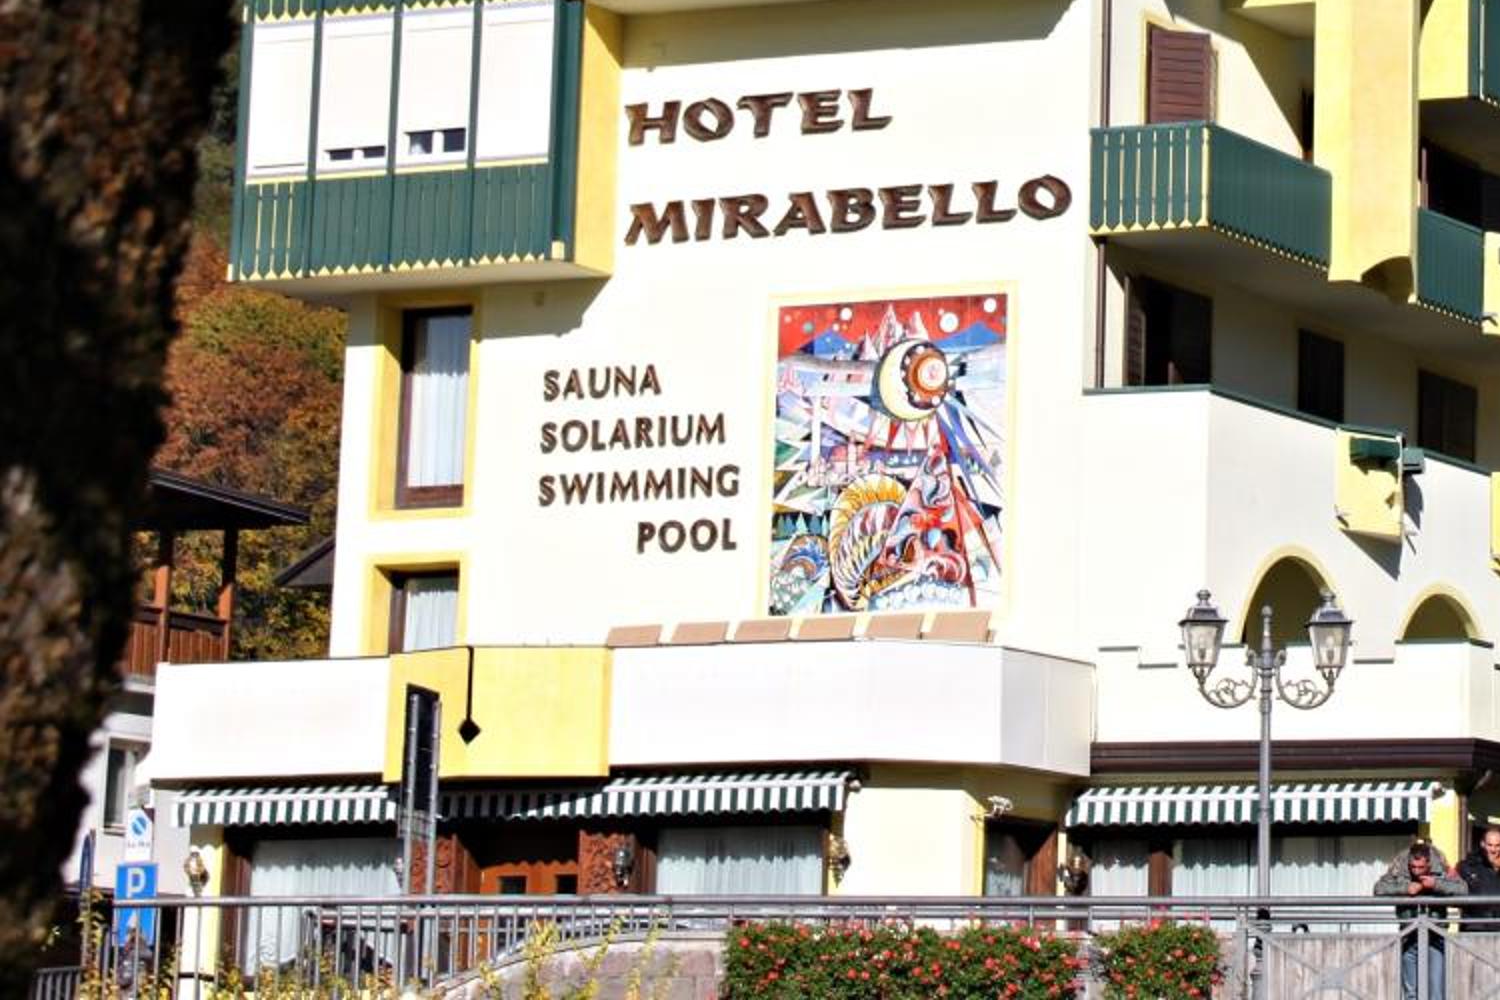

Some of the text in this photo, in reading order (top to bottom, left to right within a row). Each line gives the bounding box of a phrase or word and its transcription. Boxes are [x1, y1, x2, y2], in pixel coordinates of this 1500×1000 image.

[625, 87, 892, 146] HOTEL
[624, 174, 1072, 245] MIRABELLO
[543, 364, 662, 402] SAUNA
[540, 413, 726, 454] SOLARIUM
[538, 464, 740, 507] SWIMMING
[637, 518, 737, 554] POOL
[126, 867, 146, 897] P
